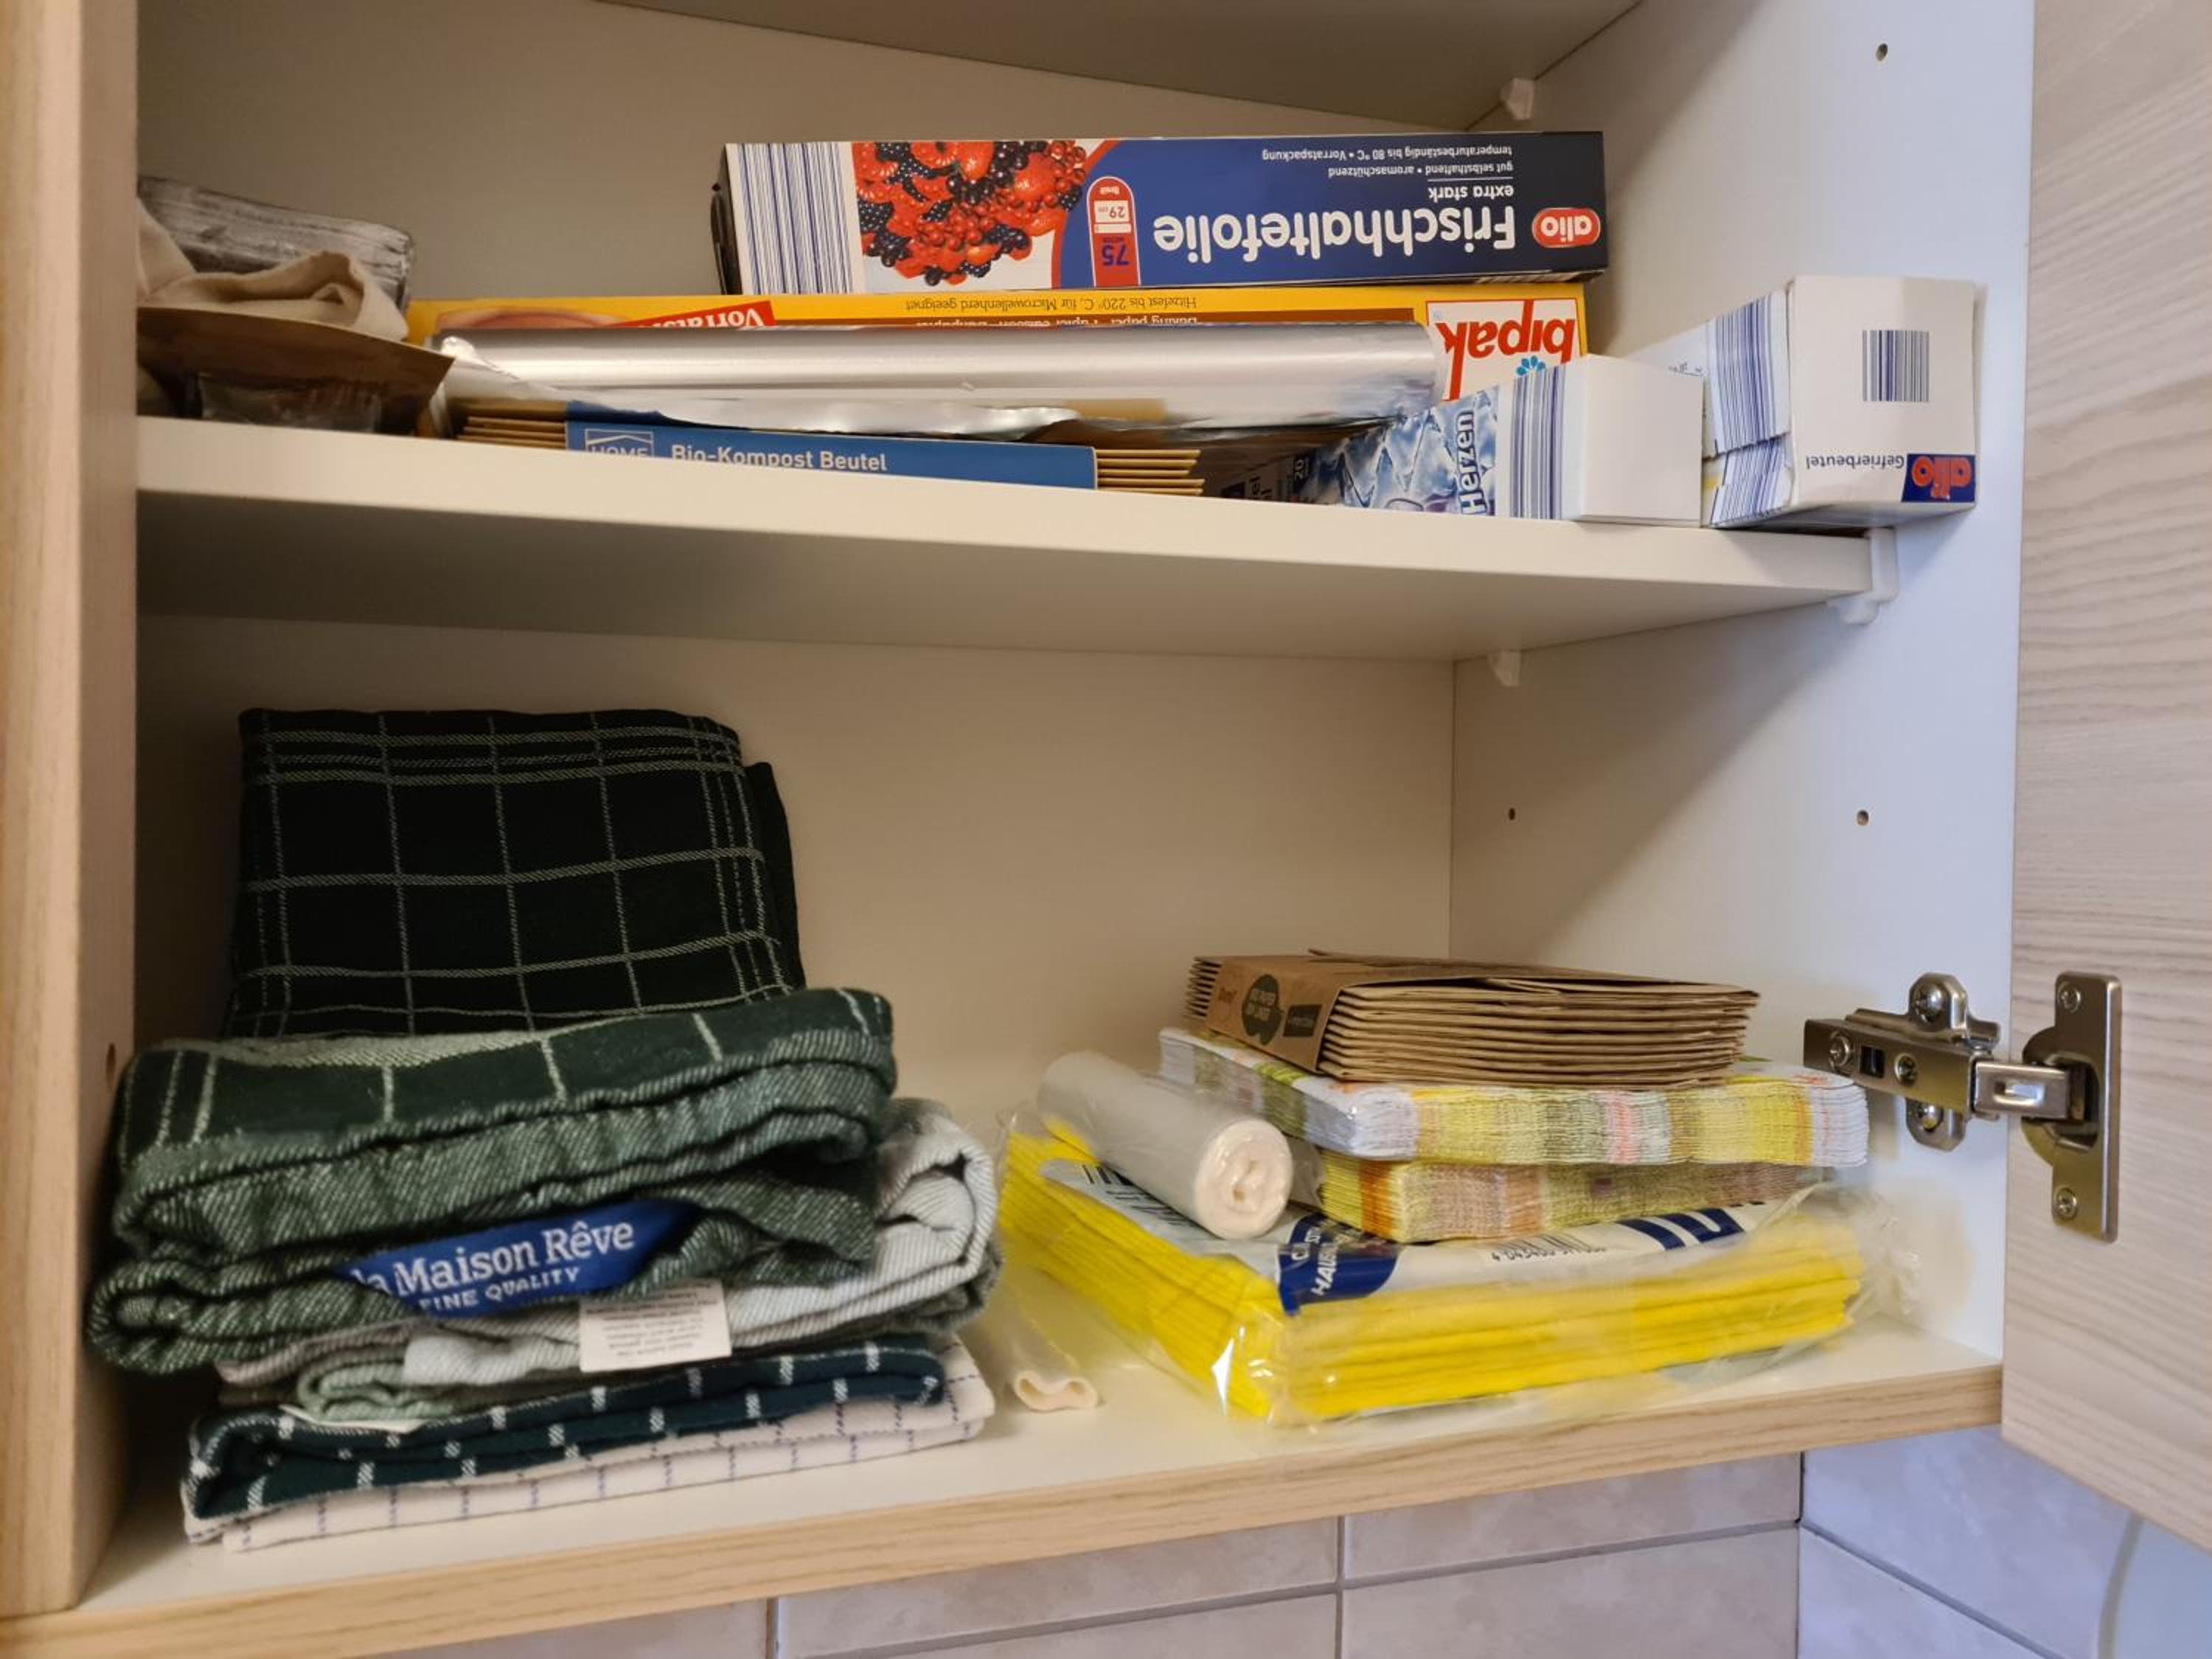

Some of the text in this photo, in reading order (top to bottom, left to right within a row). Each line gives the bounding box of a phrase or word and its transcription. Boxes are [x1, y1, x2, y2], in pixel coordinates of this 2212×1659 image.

[1262, 145, 1512, 162] temperaturbeständig bis 80 °C Vorratspackung
[1327, 163, 1514, 179] gut selbsthaftend aromaschützend
[1427, 184, 1514, 204] extra stark
[1109, 206, 1126, 219] 29
[1153, 206, 1516, 264] Frischhaltefolie
[1540, 215, 1592, 239] alio
[1102, 244, 1130, 268] 75
[905, 297, 957, 312] geeignet
[961, 298, 1057, 313] Microwellenherd
[1061, 298, 1077, 311] für
[1129, 297, 1147, 310] bis
[1148, 296, 1197, 310] Hitzefest
[1436, 299, 1576, 401] bipak
[819, 451, 888, 471] Beutel
[1455, 411, 1488, 516] Herzen
[1806, 454, 1905, 470] Gefrierbeutel
[1910, 455, 1972, 501] alio
[393, 1239, 540, 1297] Maison
[543, 1221, 636, 1257] Rêve
[485, 1266, 581, 1304] QUALITY
